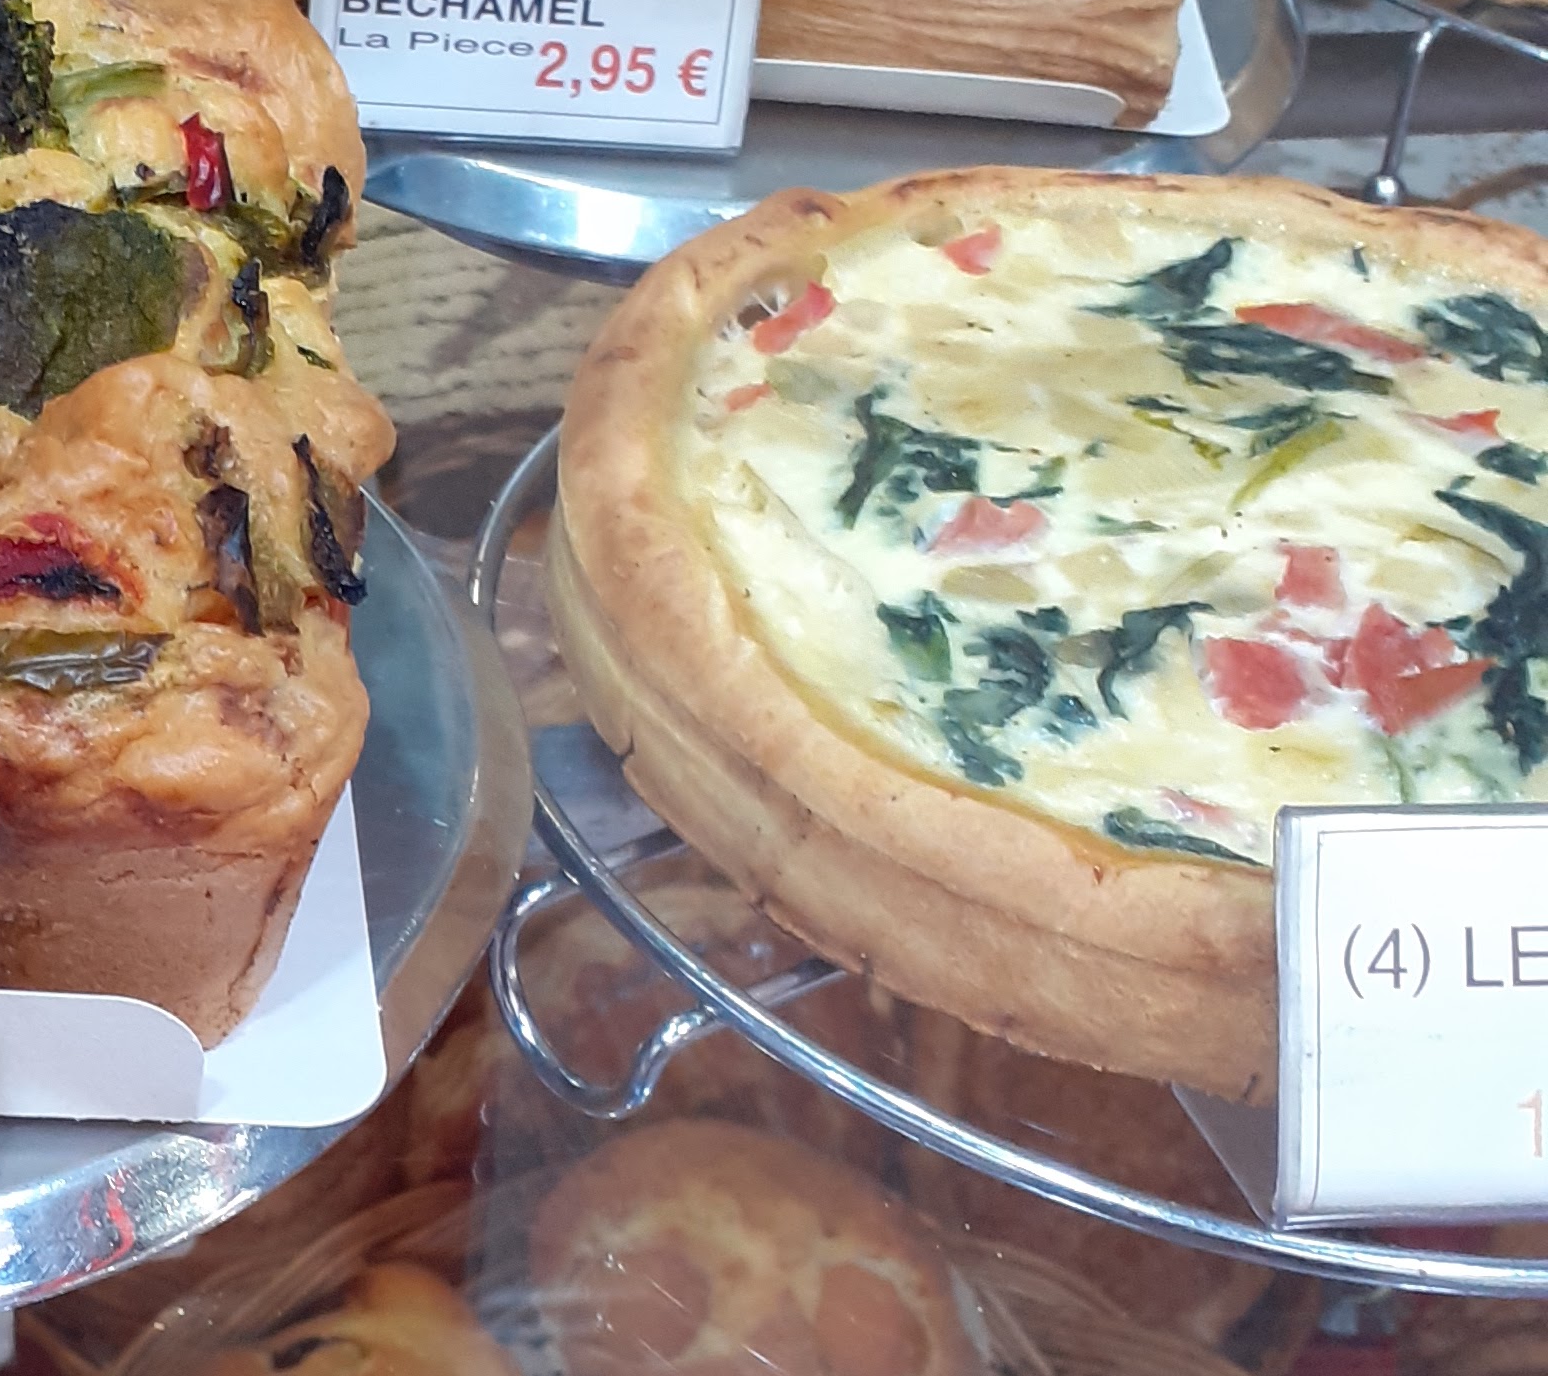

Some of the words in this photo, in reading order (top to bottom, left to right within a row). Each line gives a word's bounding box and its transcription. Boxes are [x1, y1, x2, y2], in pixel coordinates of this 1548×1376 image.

[338, 28, 390, 50] La
[409, 31, 535, 58] Piece
[535, 41, 656, 99] 2,95
[677, 48, 714, 97] €
[1343, 923, 1431, 999] (4)
